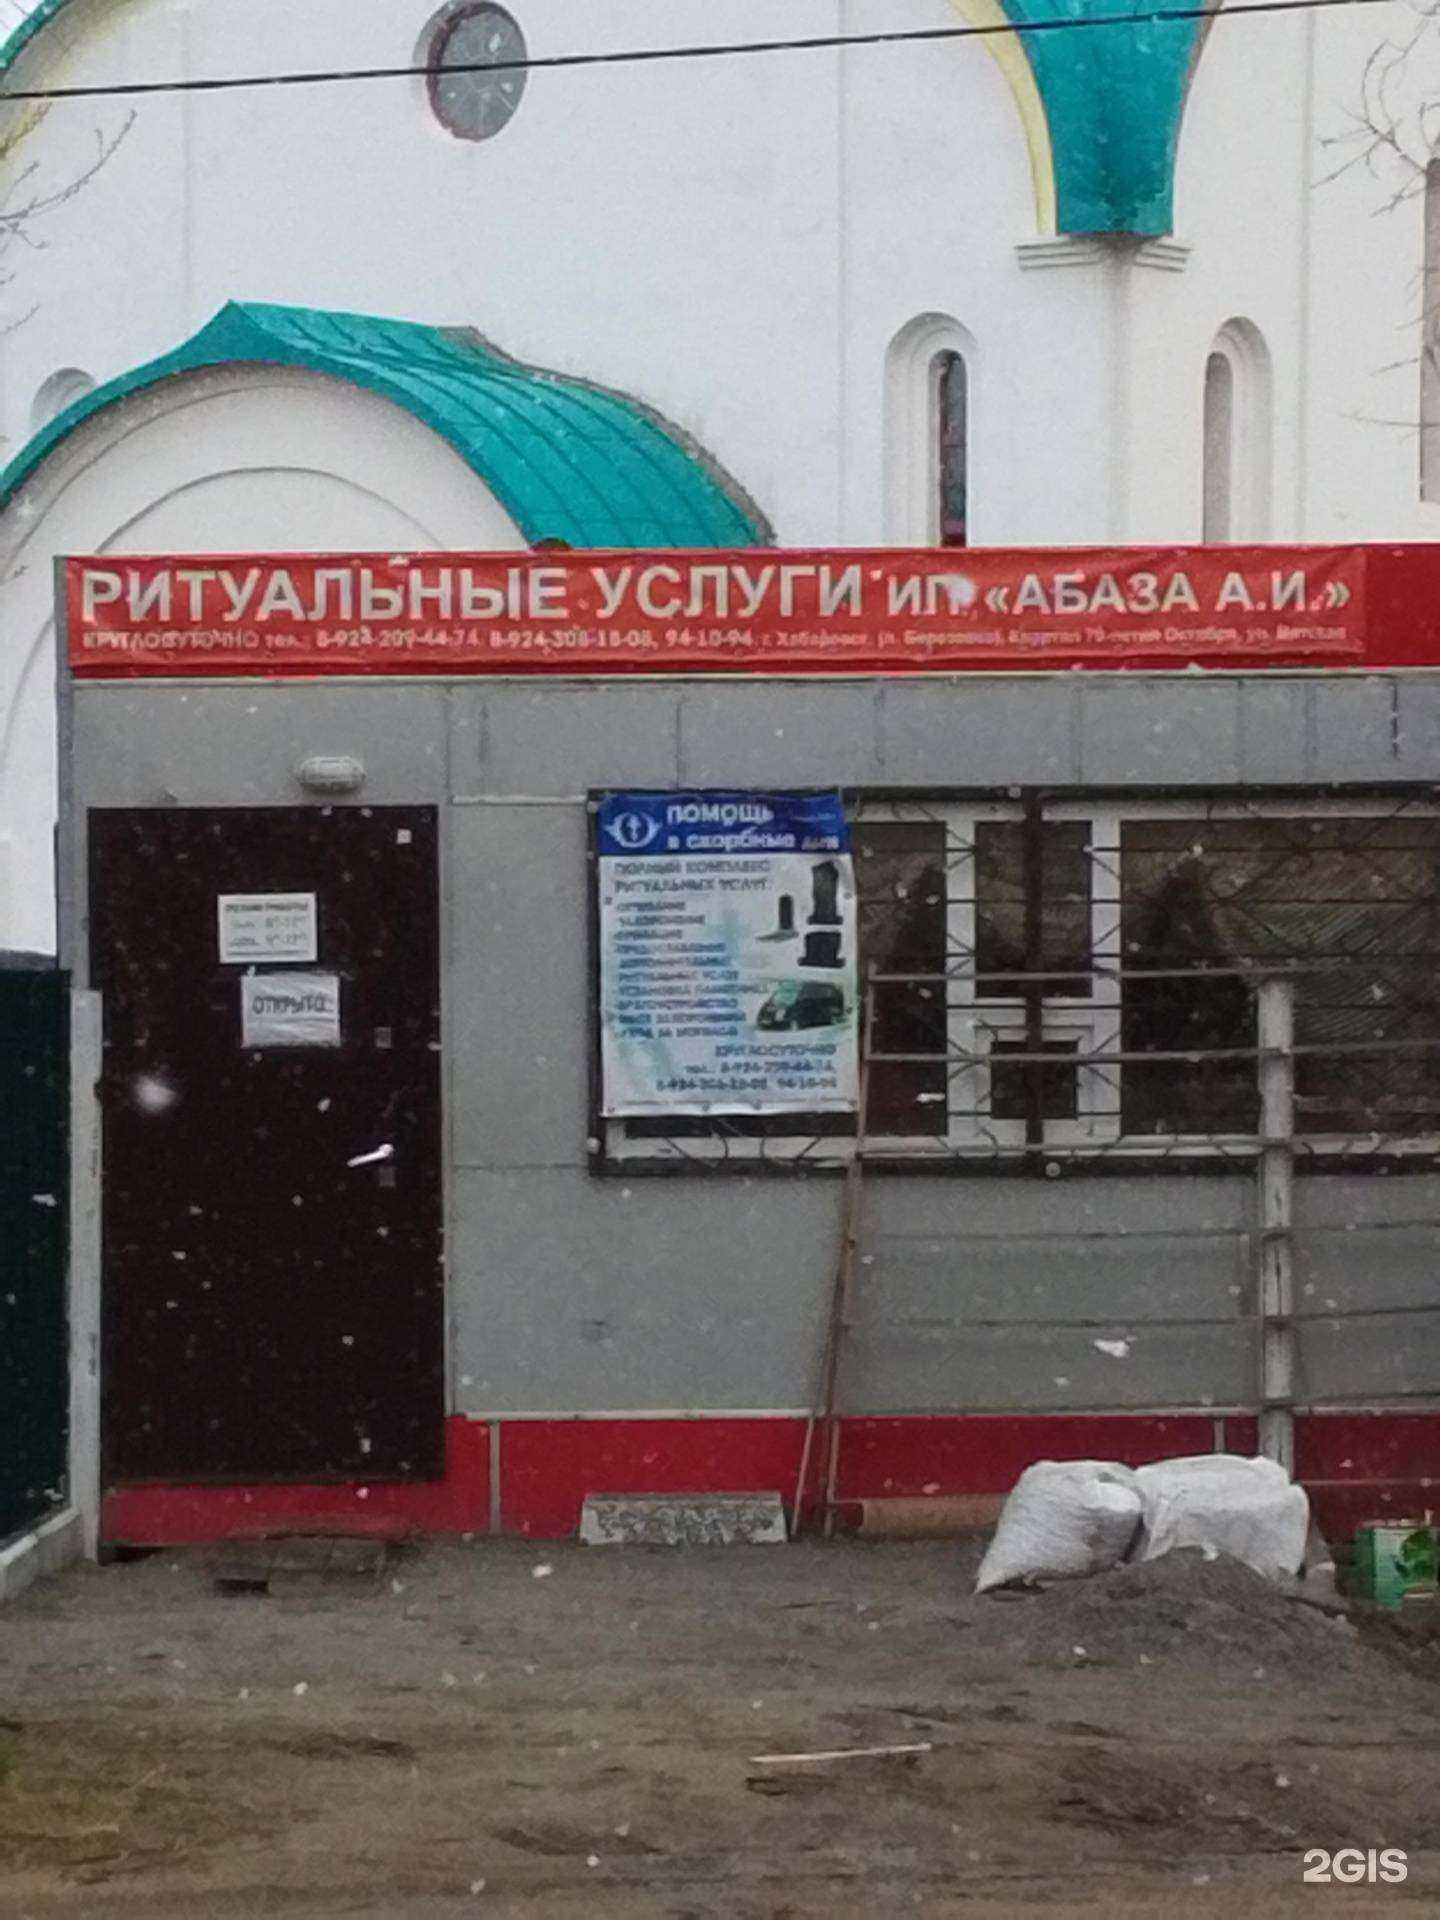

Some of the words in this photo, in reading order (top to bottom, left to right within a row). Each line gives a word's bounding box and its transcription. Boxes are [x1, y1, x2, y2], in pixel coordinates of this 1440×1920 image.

[81, 566, 569, 623] РИТУАЛЬНЫЕ
[590, 564, 863, 620] УСЛУГИ
[983, 570, 1200, 617] «АБАЗА
